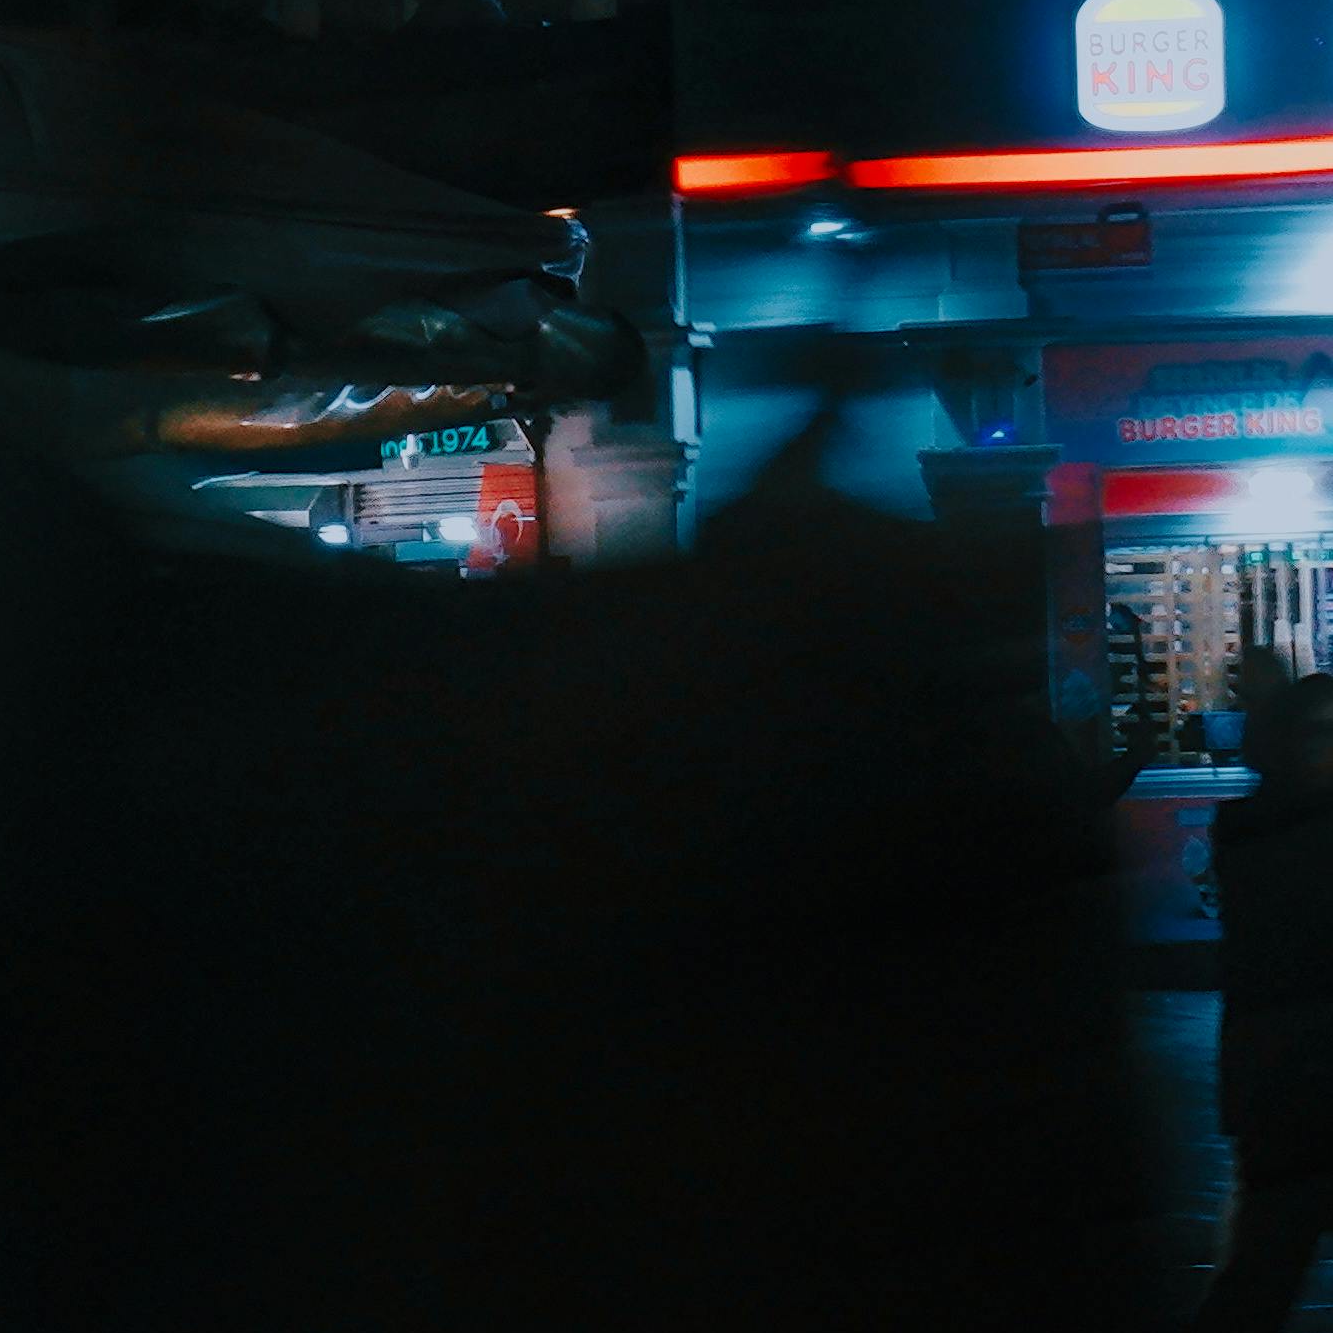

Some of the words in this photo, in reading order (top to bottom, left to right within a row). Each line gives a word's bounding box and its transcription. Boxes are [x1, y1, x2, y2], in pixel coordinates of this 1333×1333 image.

[1090, 30, 1209, 56] BURGER
[1092, 58, 1210, 95] KING
[431, 426, 490, 454] 1974
[1119, 415, 1236, 442] BURGER
[1246, 409, 1320, 435] KING
